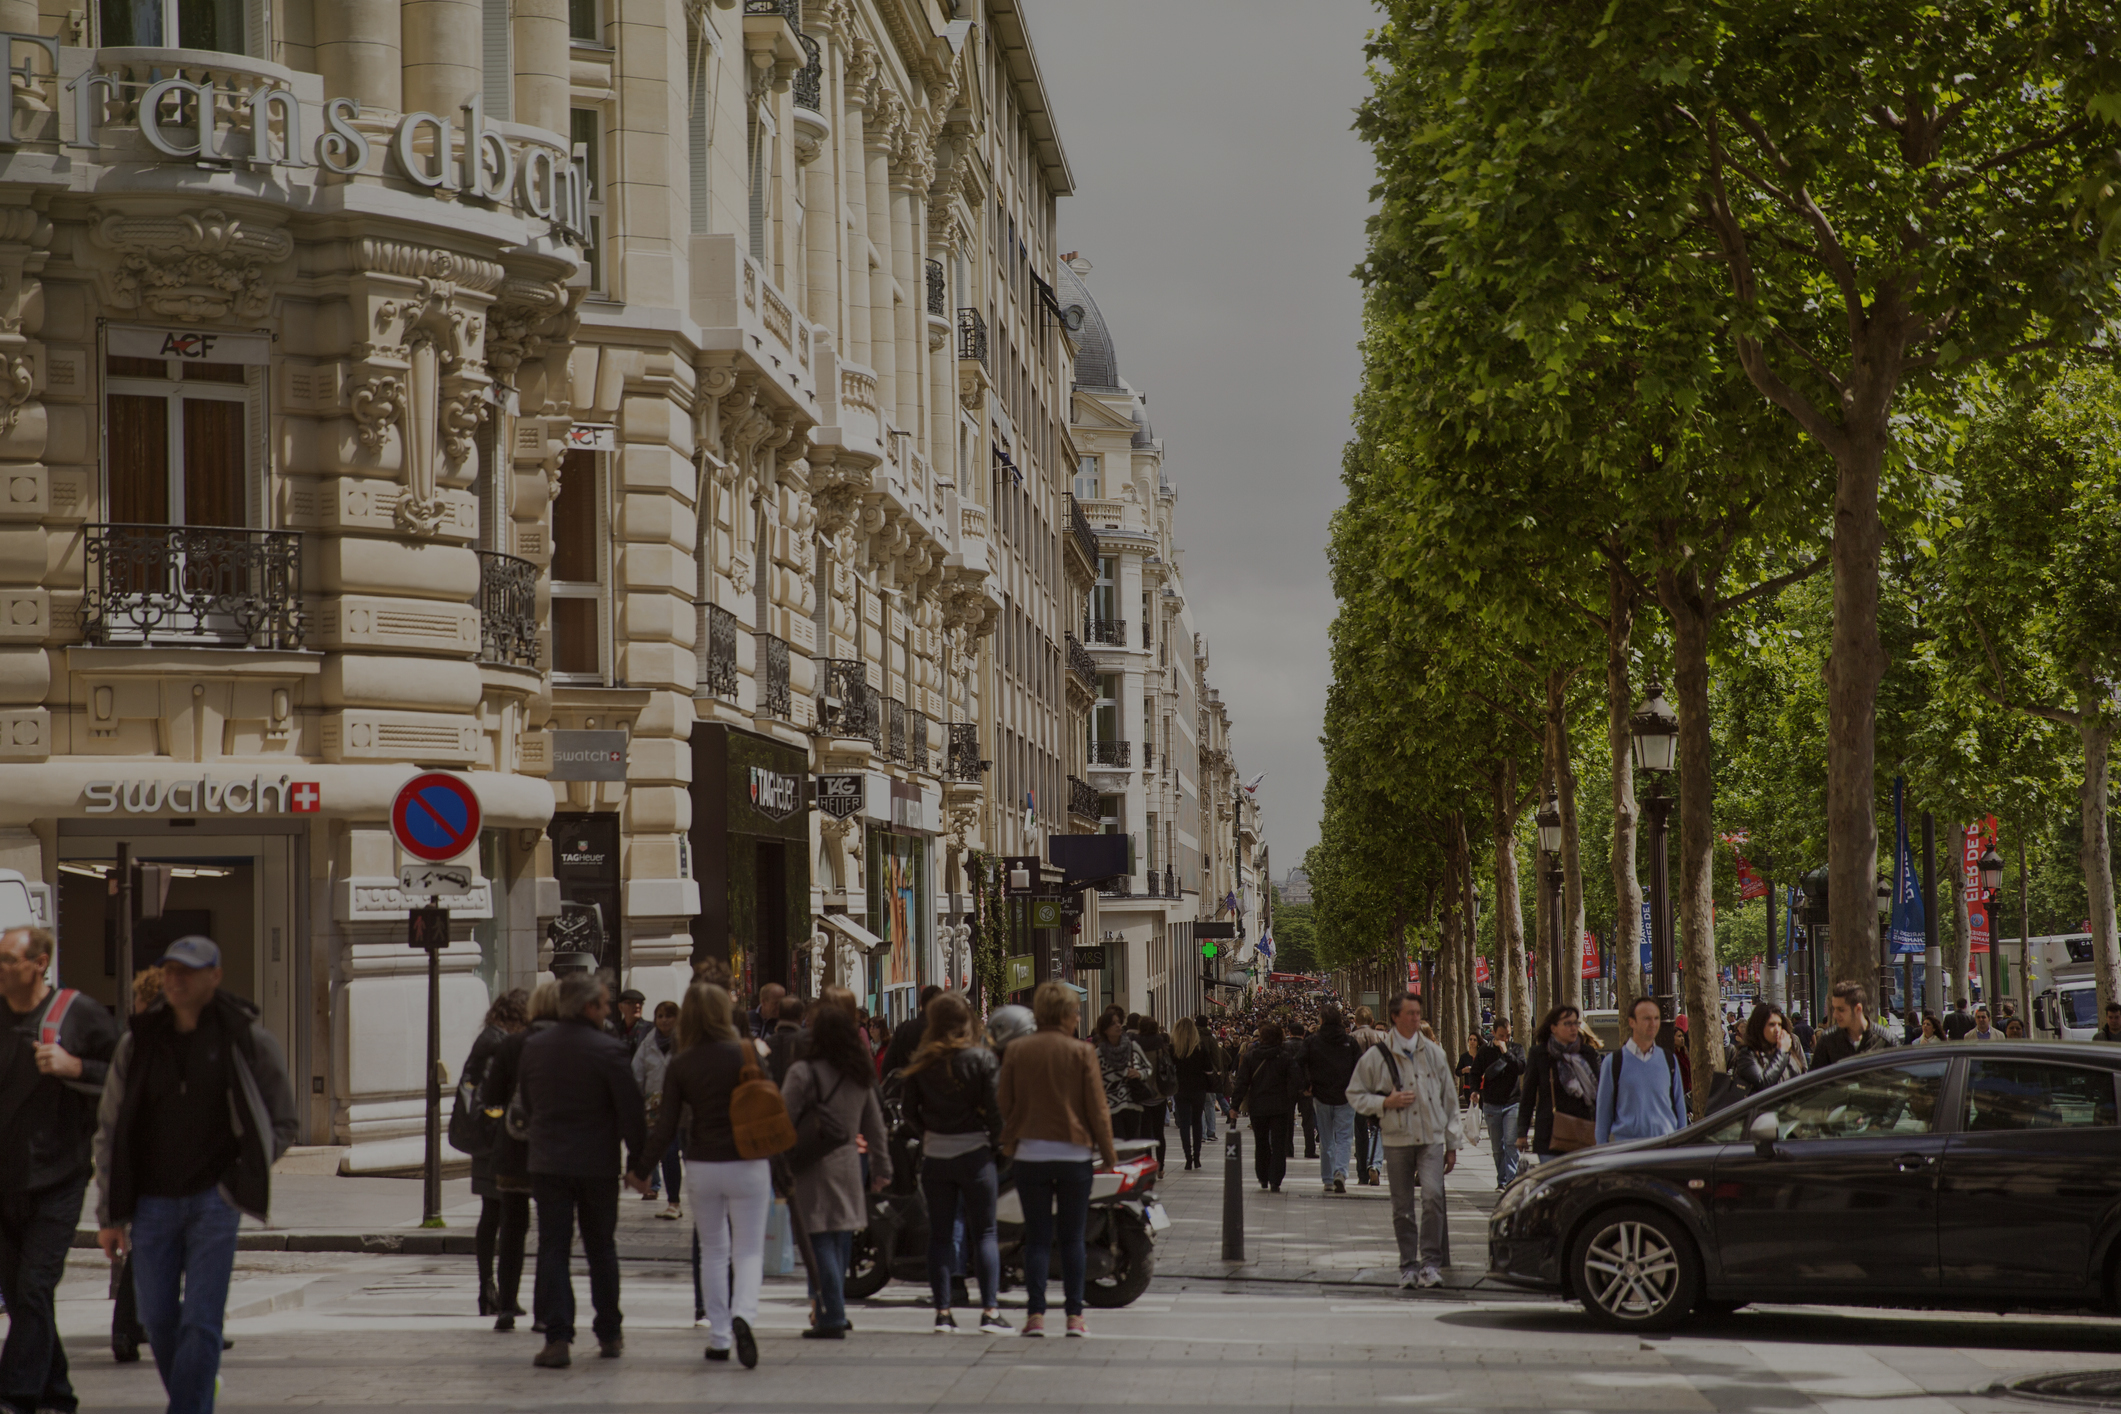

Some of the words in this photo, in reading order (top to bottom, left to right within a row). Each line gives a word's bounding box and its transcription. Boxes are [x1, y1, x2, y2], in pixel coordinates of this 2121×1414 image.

[160, 332, 218, 358] ACF
[553, 749, 609, 761] swatch
[84, 773, 286, 813] swatch
[824, 777, 856, 795] TAG
[820, 798, 860, 817] HEUER
[1060, 896, 1073, 905] Jeff
[1075, 951, 1103, 964] M&S
